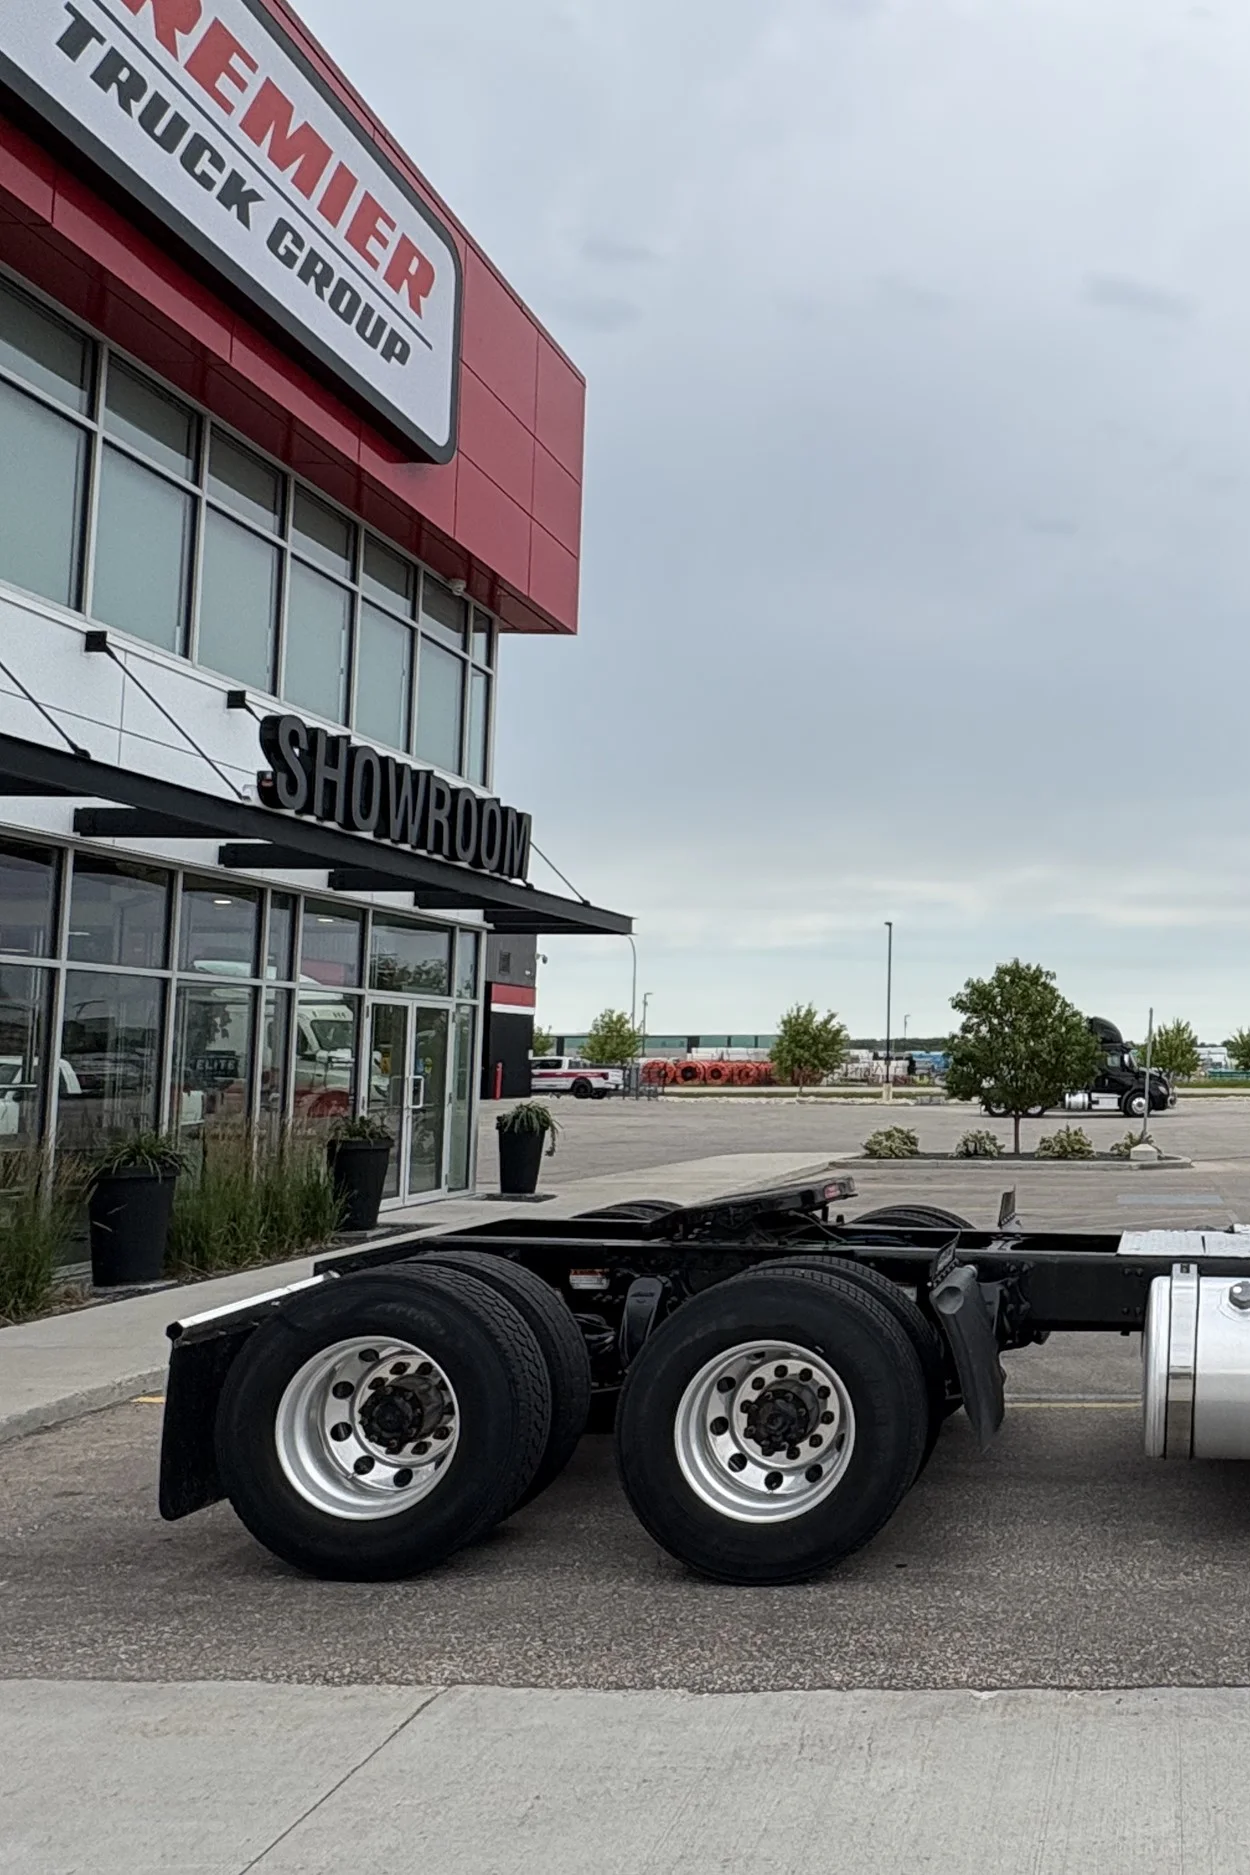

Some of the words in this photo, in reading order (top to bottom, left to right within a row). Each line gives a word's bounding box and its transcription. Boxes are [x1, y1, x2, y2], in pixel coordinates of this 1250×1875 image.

[56, 1, 265, 232] TRUCK
[266, 217, 412, 367] GROUP
[120, 0, 436, 320] REMIER
[262, 714, 532, 881] SHOWROOM
